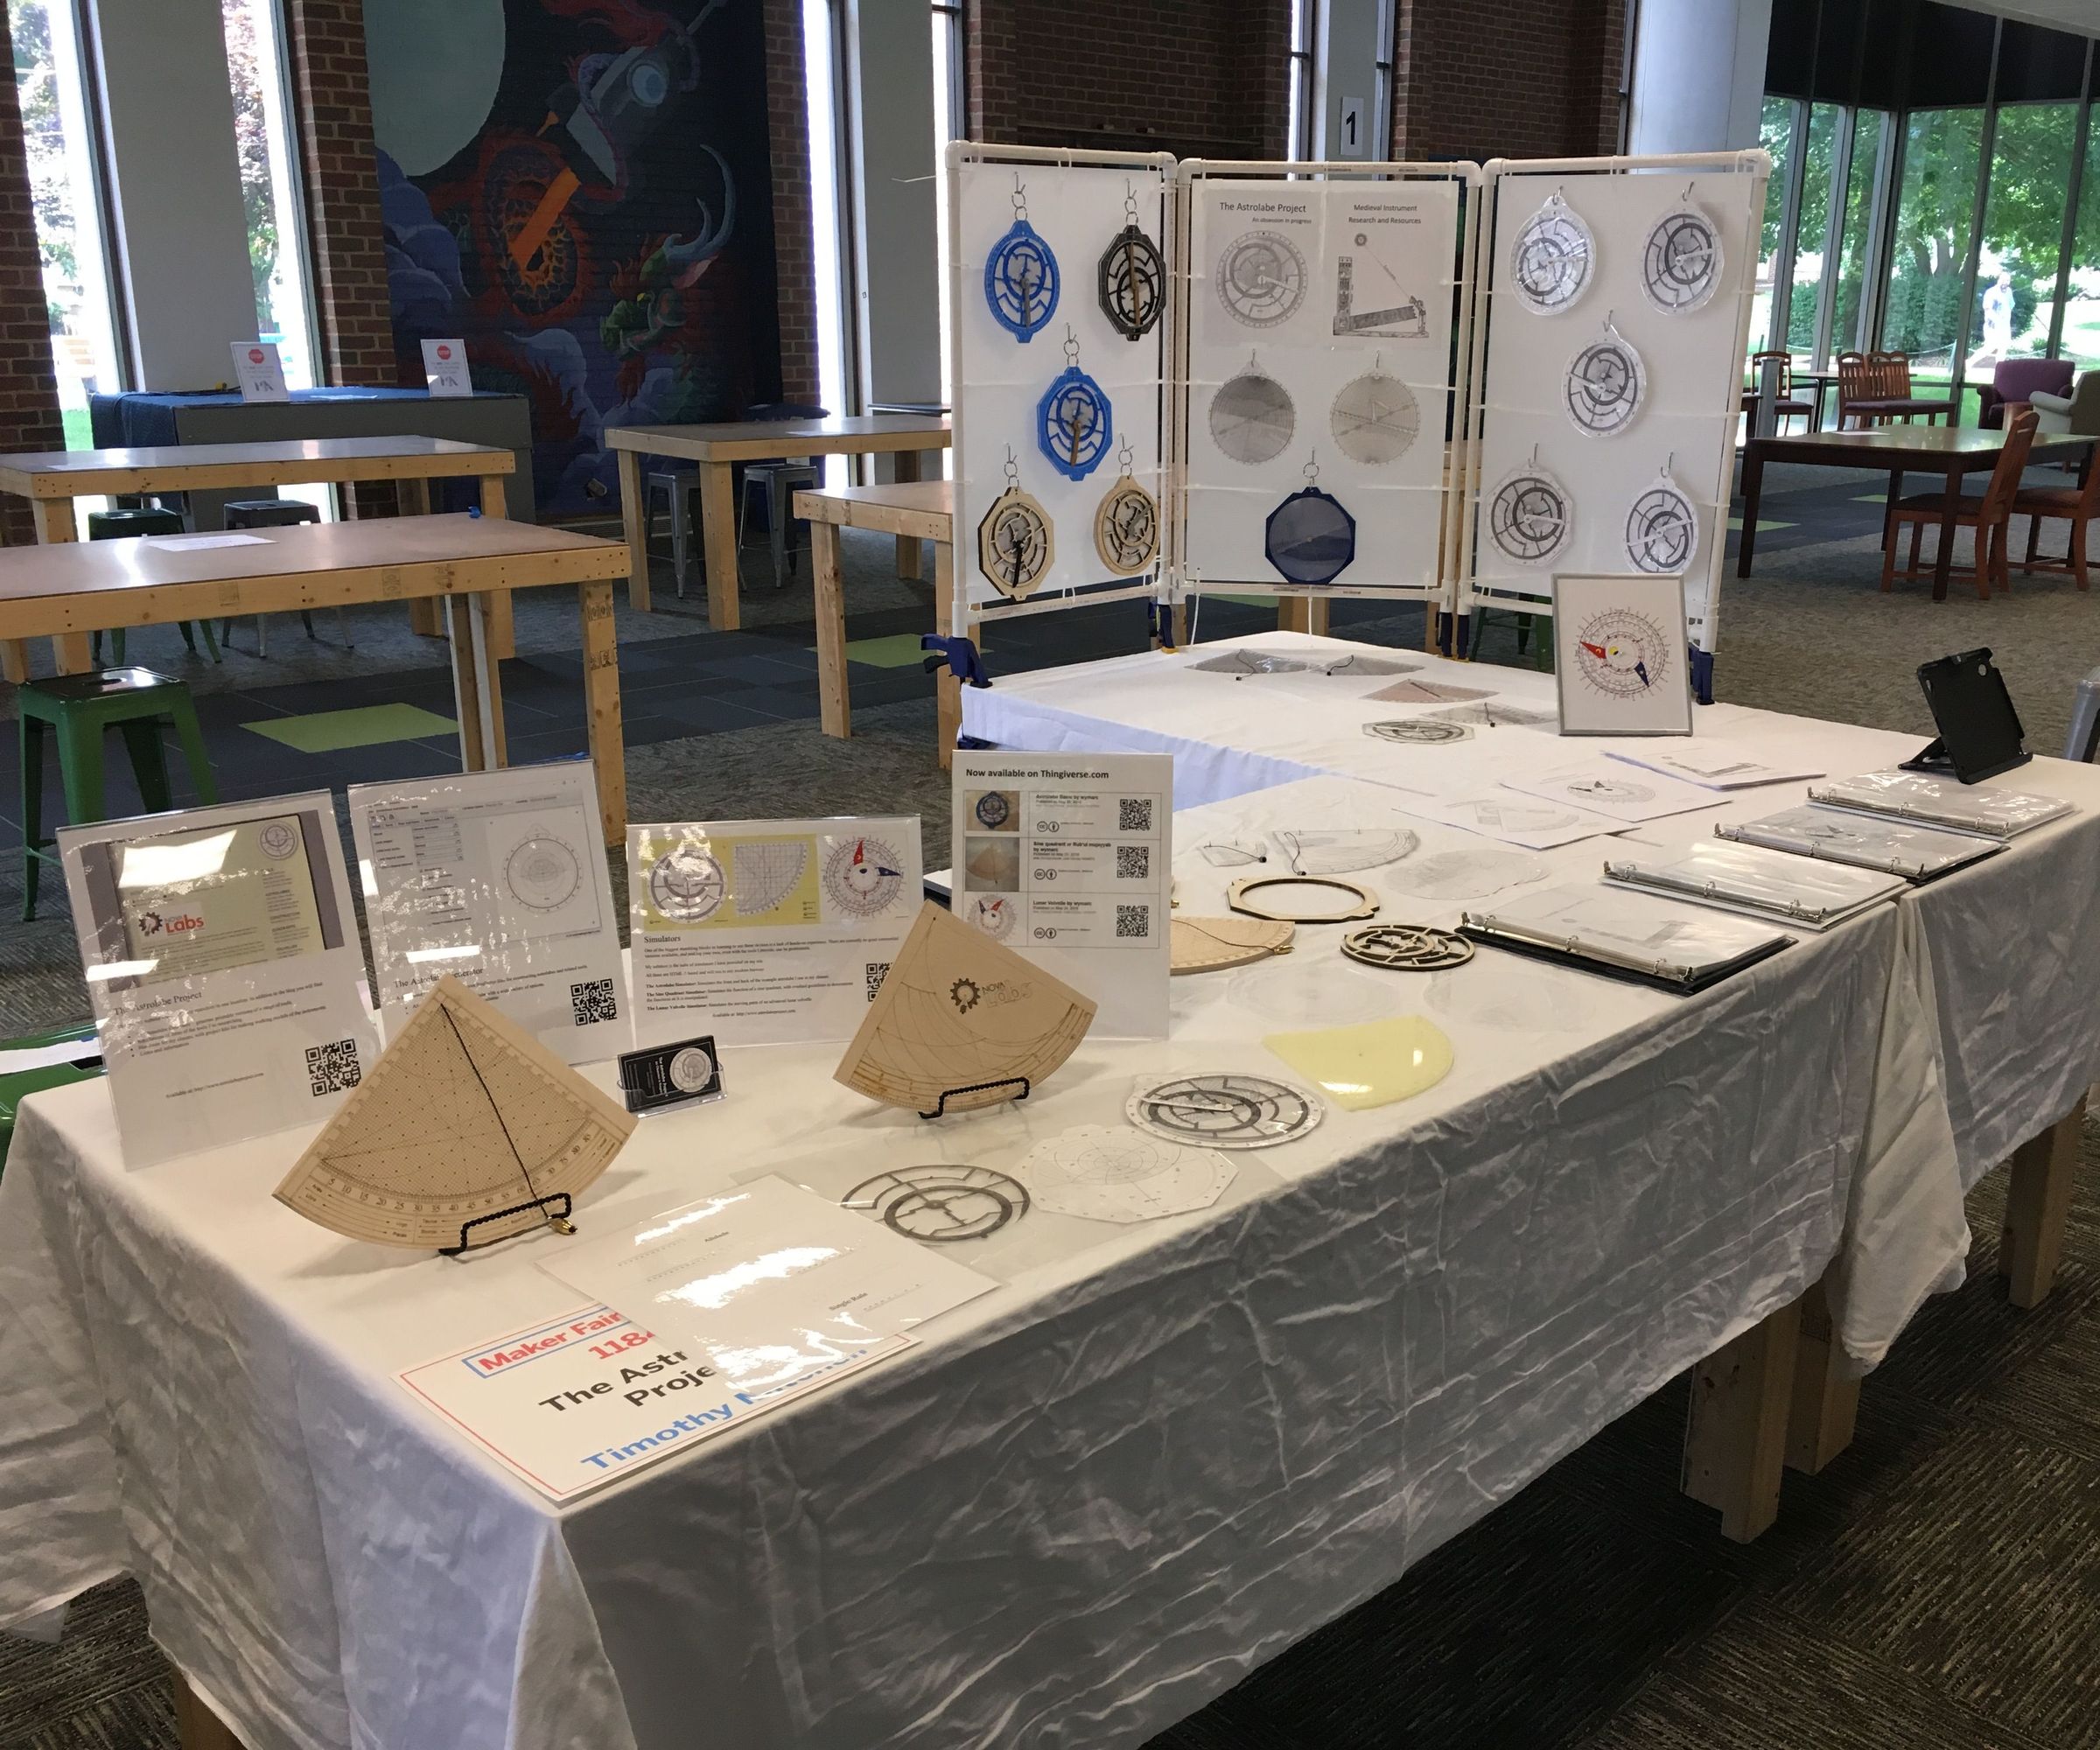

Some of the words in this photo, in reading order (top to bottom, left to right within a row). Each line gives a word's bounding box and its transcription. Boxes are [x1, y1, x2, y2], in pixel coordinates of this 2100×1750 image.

[1347, 111, 1356, 145] 1
[1220, 202, 1235, 211] The
[1236, 202, 1276, 212] Astrolabe
[1278, 203, 1306, 214] Project
[966, 768, 986, 778] Now
[988, 768, 1026, 778] available
[1040, 769, 1110, 780] Thingiverse.com
[165, 914, 205, 934] Labs
[644, 934, 681, 944] Simulators
[453, 968, 484, 978] enerator
[172, 991, 202, 1004] Project
[341, 1185, 352, 1194] 10
[360, 1192, 369, 1201] 15
[395, 1201, 405, 1210] 25
[571, 1144, 581, 1154] 80
[478, 1332, 567, 1371] Maker
[570, 1312, 626, 1336] Fair
[538, 1381, 615, 1412] The
[620, 1350, 690, 1384] Astr
[623, 1365, 718, 1407] Proje
[580, 1404, 733, 1469] Timothy
